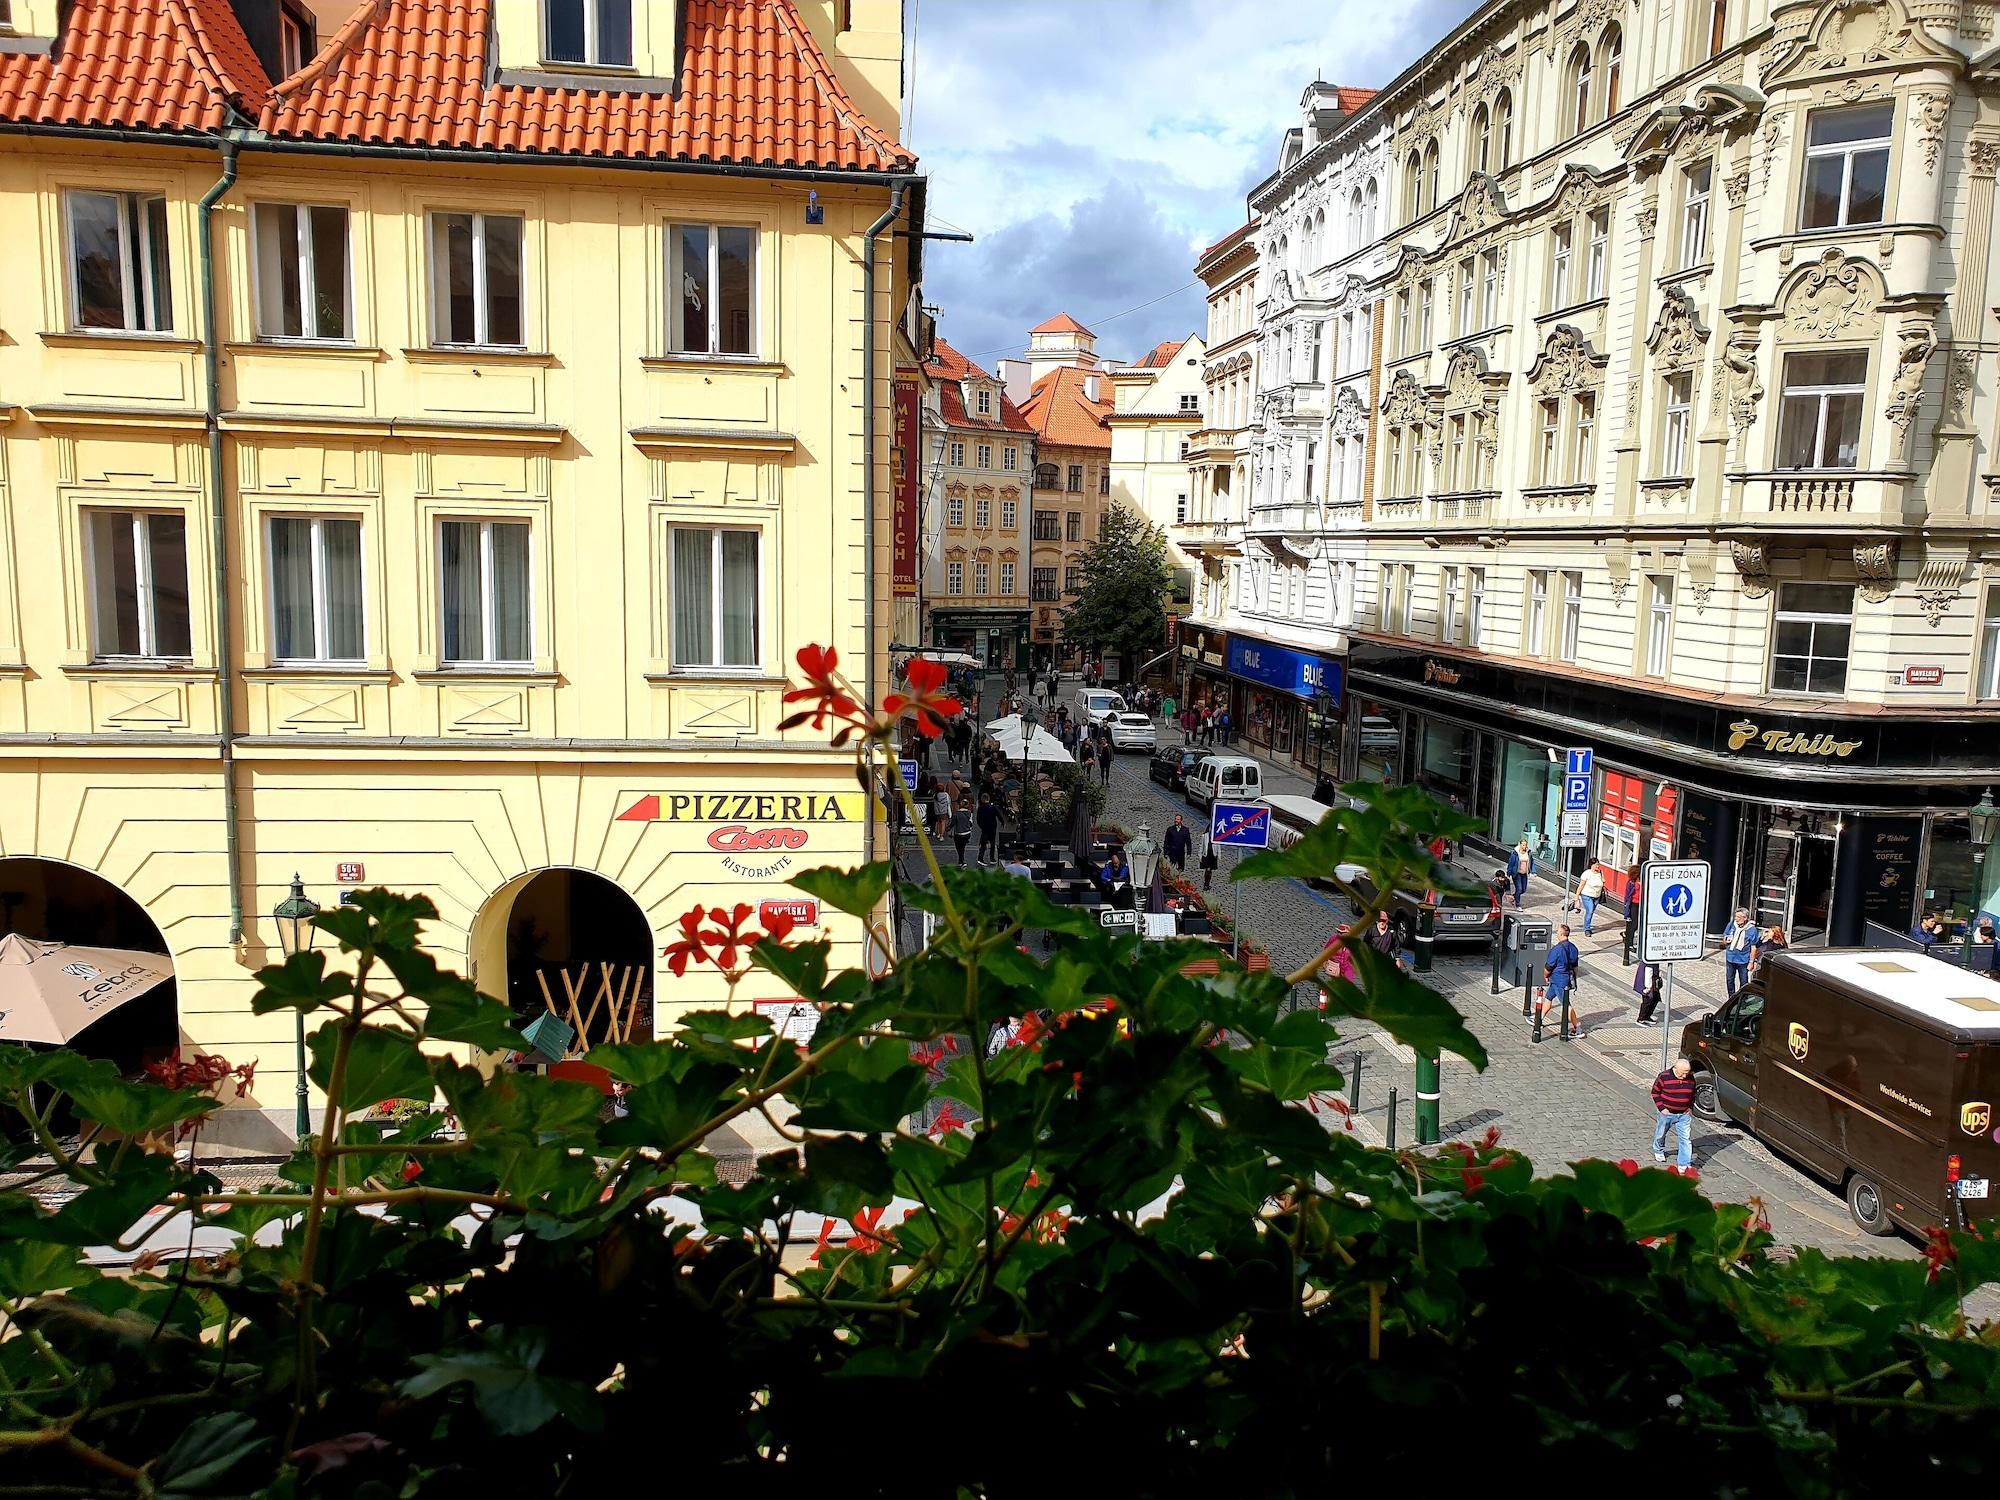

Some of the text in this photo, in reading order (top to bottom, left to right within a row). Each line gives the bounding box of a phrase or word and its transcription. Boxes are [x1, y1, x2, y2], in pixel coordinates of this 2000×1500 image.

[895, 383, 915, 391] OTEL
[1244, 649, 1260, 668] BLUE
[1303, 664, 1323, 686] BLUE
[1762, 730, 1862, 757] Tchibo
[669, 795, 846, 820] PIZZERIA
[341, 864, 357, 873] 504
[721, 855, 792, 878] RISTORANTE
[1677, 868, 1702, 879] ZÓNA
[1112, 913, 1125, 923] WC
[78, 963, 147, 1003] zebra
[1791, 1033, 1807, 1054] ups
[1880, 1083, 1932, 1116] Worldwide Services
[1963, 1112, 1988, 1131] ups
